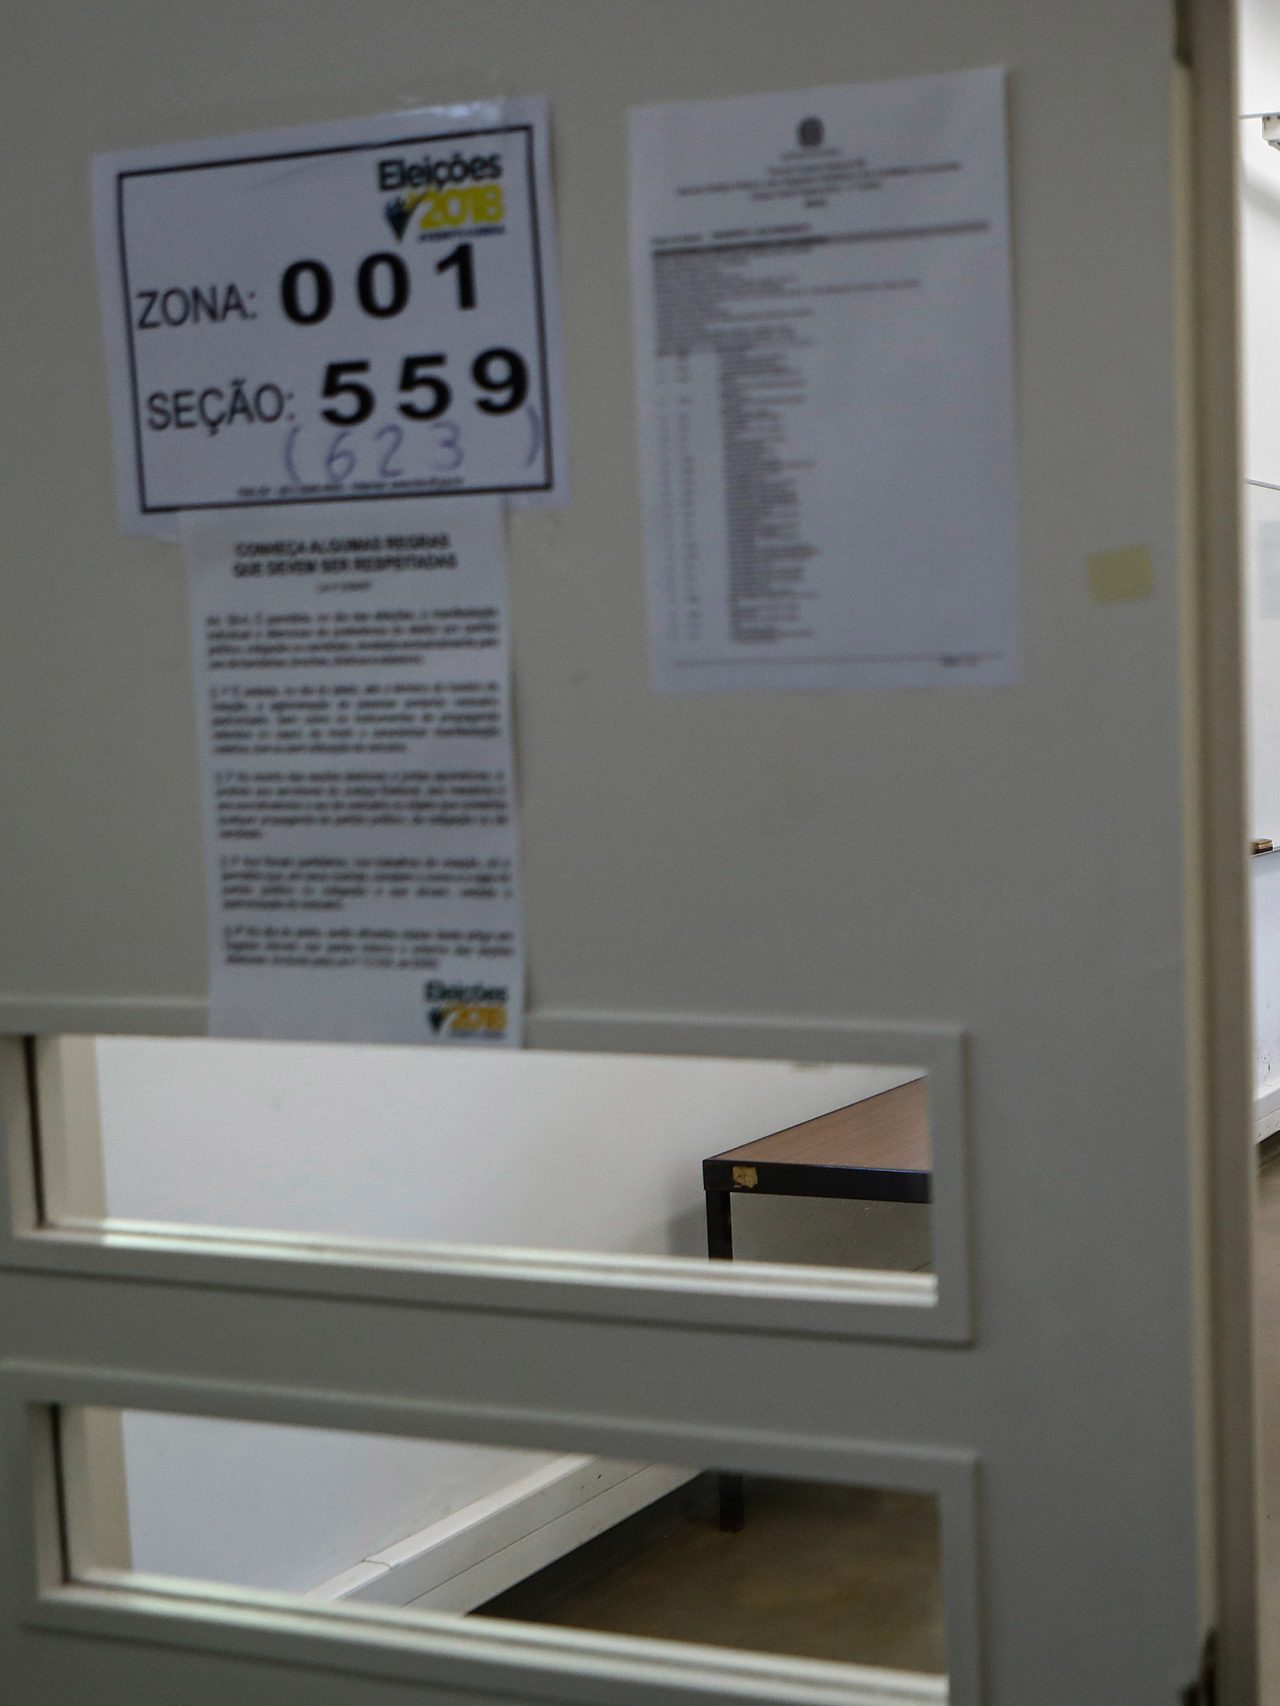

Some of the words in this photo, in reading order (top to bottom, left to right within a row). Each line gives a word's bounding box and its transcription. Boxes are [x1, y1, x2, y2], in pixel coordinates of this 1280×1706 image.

[378, 152, 503, 191] Eleições
[418, 183, 505, 229] 2018
[137, 284, 257, 329] ZONA:
[147, 380, 297, 436] SEÇÃO:
